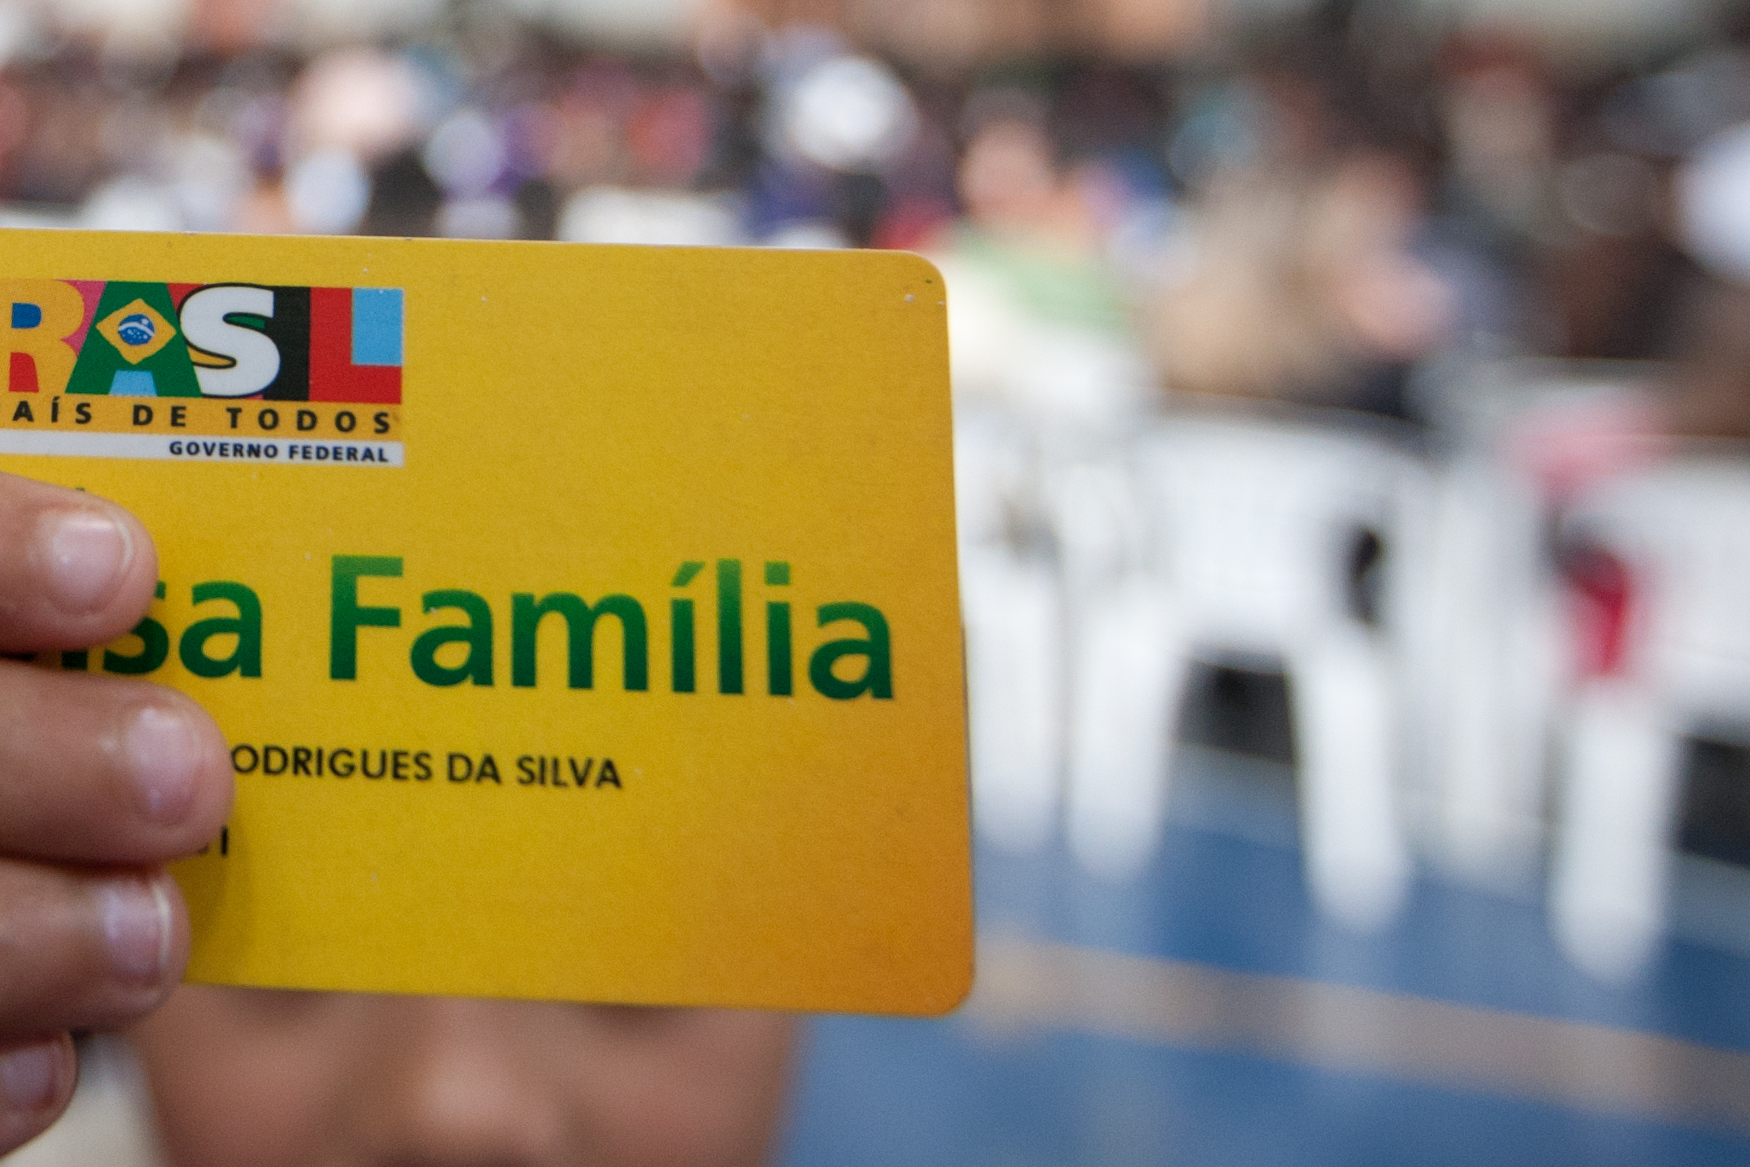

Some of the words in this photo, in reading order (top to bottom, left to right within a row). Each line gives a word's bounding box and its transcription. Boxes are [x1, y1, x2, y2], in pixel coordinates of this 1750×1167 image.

[132, 404, 187, 428] DE
[225, 407, 390, 434] TODOS
[168, 440, 279, 459] GOVERNO
[288, 444, 389, 463] FEDERAL
[329, 555, 894, 702] Família
[231, 744, 433, 781] ODRIGUES
[447, 753, 502, 784] DA
[517, 755, 622, 789] SILVA
